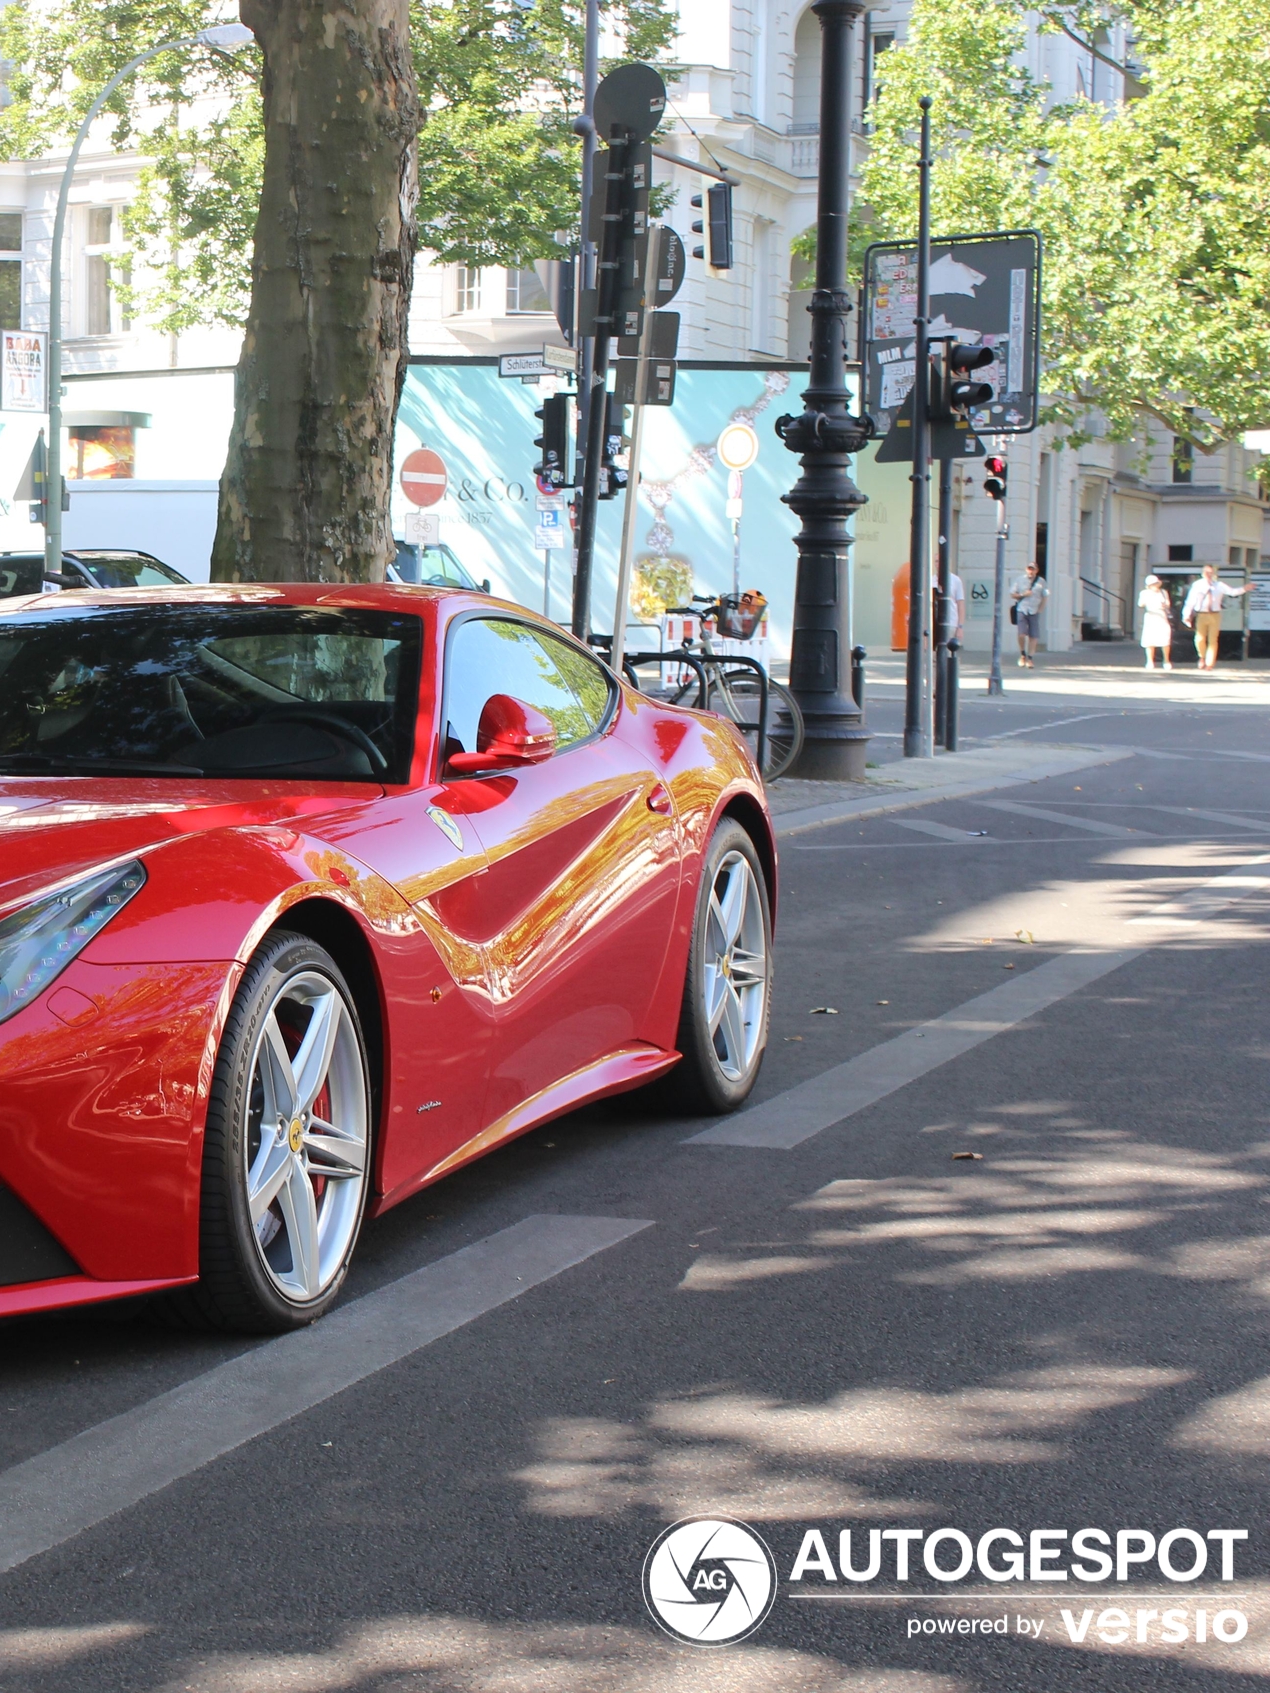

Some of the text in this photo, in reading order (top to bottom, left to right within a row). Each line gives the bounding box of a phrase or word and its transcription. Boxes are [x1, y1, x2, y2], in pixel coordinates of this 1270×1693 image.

[5, 336, 42, 353] BABA
[458, 477, 529, 502] & Co.
